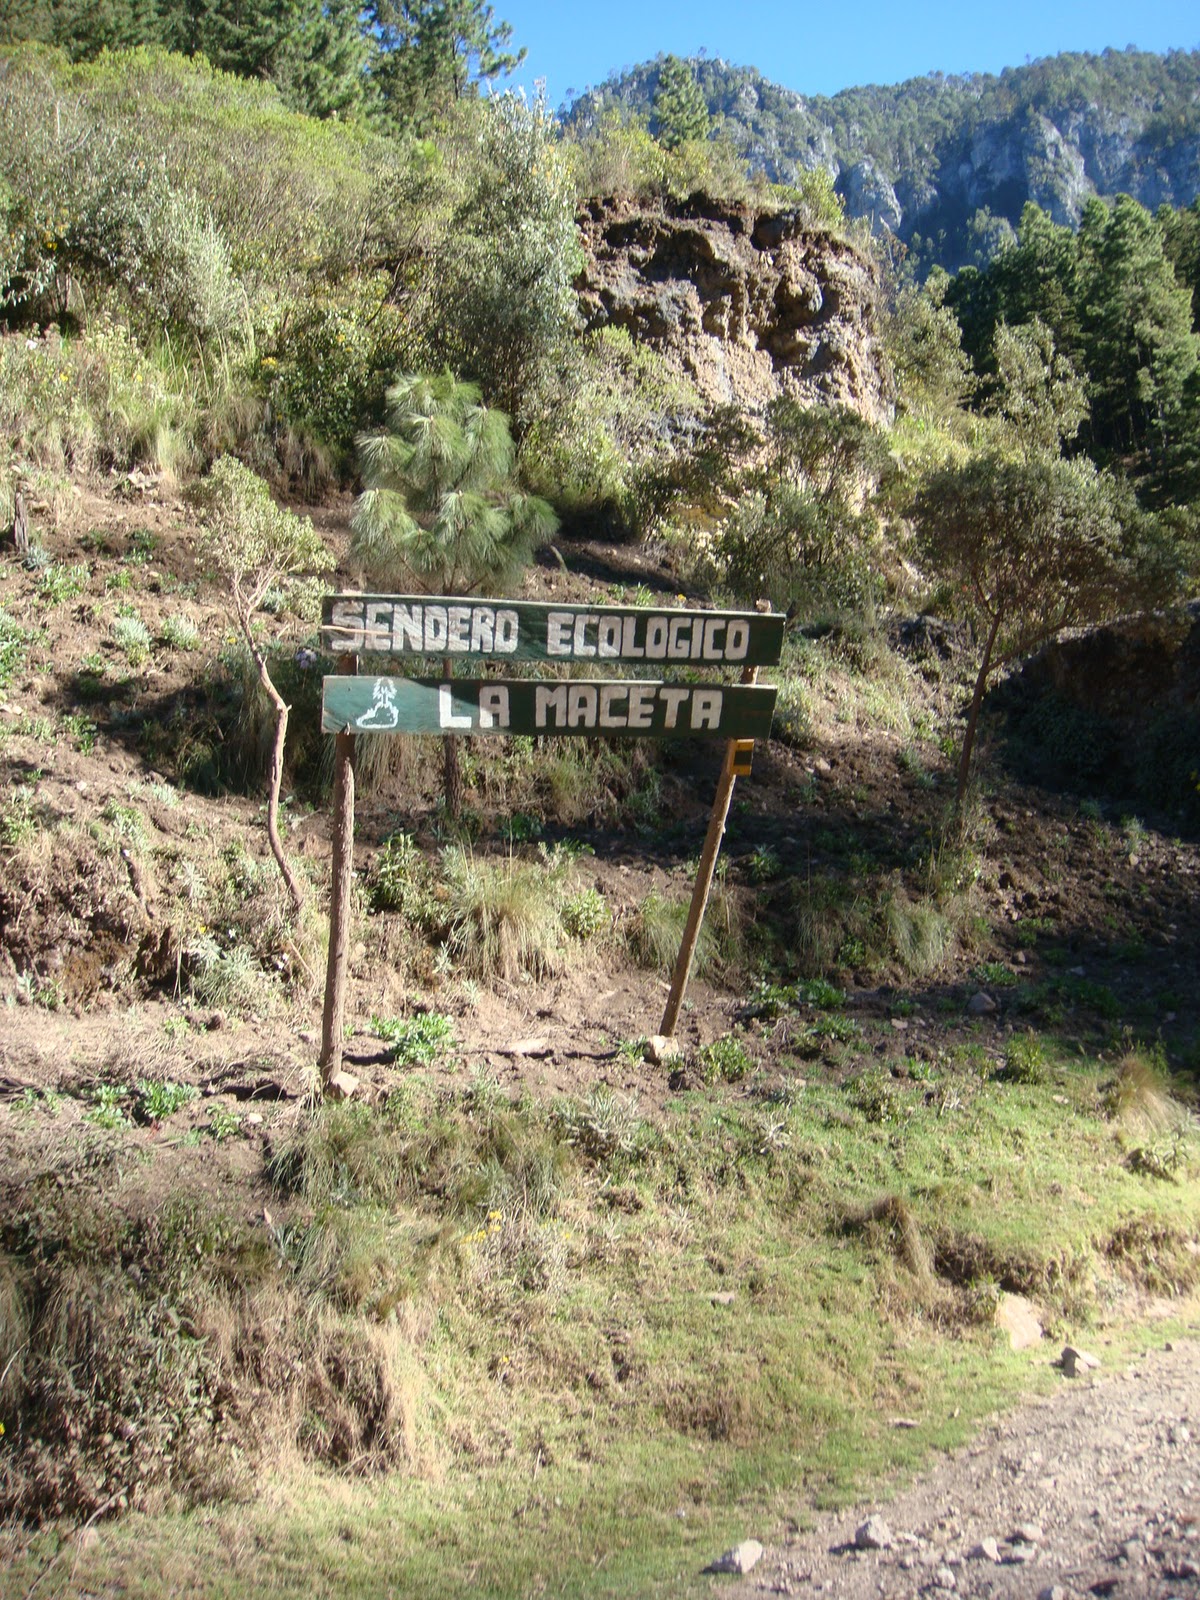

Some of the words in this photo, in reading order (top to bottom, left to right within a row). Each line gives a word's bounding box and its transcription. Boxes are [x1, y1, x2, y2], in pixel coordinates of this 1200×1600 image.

[332, 601, 519, 653] SENDERO
[546, 612, 750, 660] ECOLOGICO
[439, 684, 510, 728] LA
[535, 685, 723, 729] MACETA
